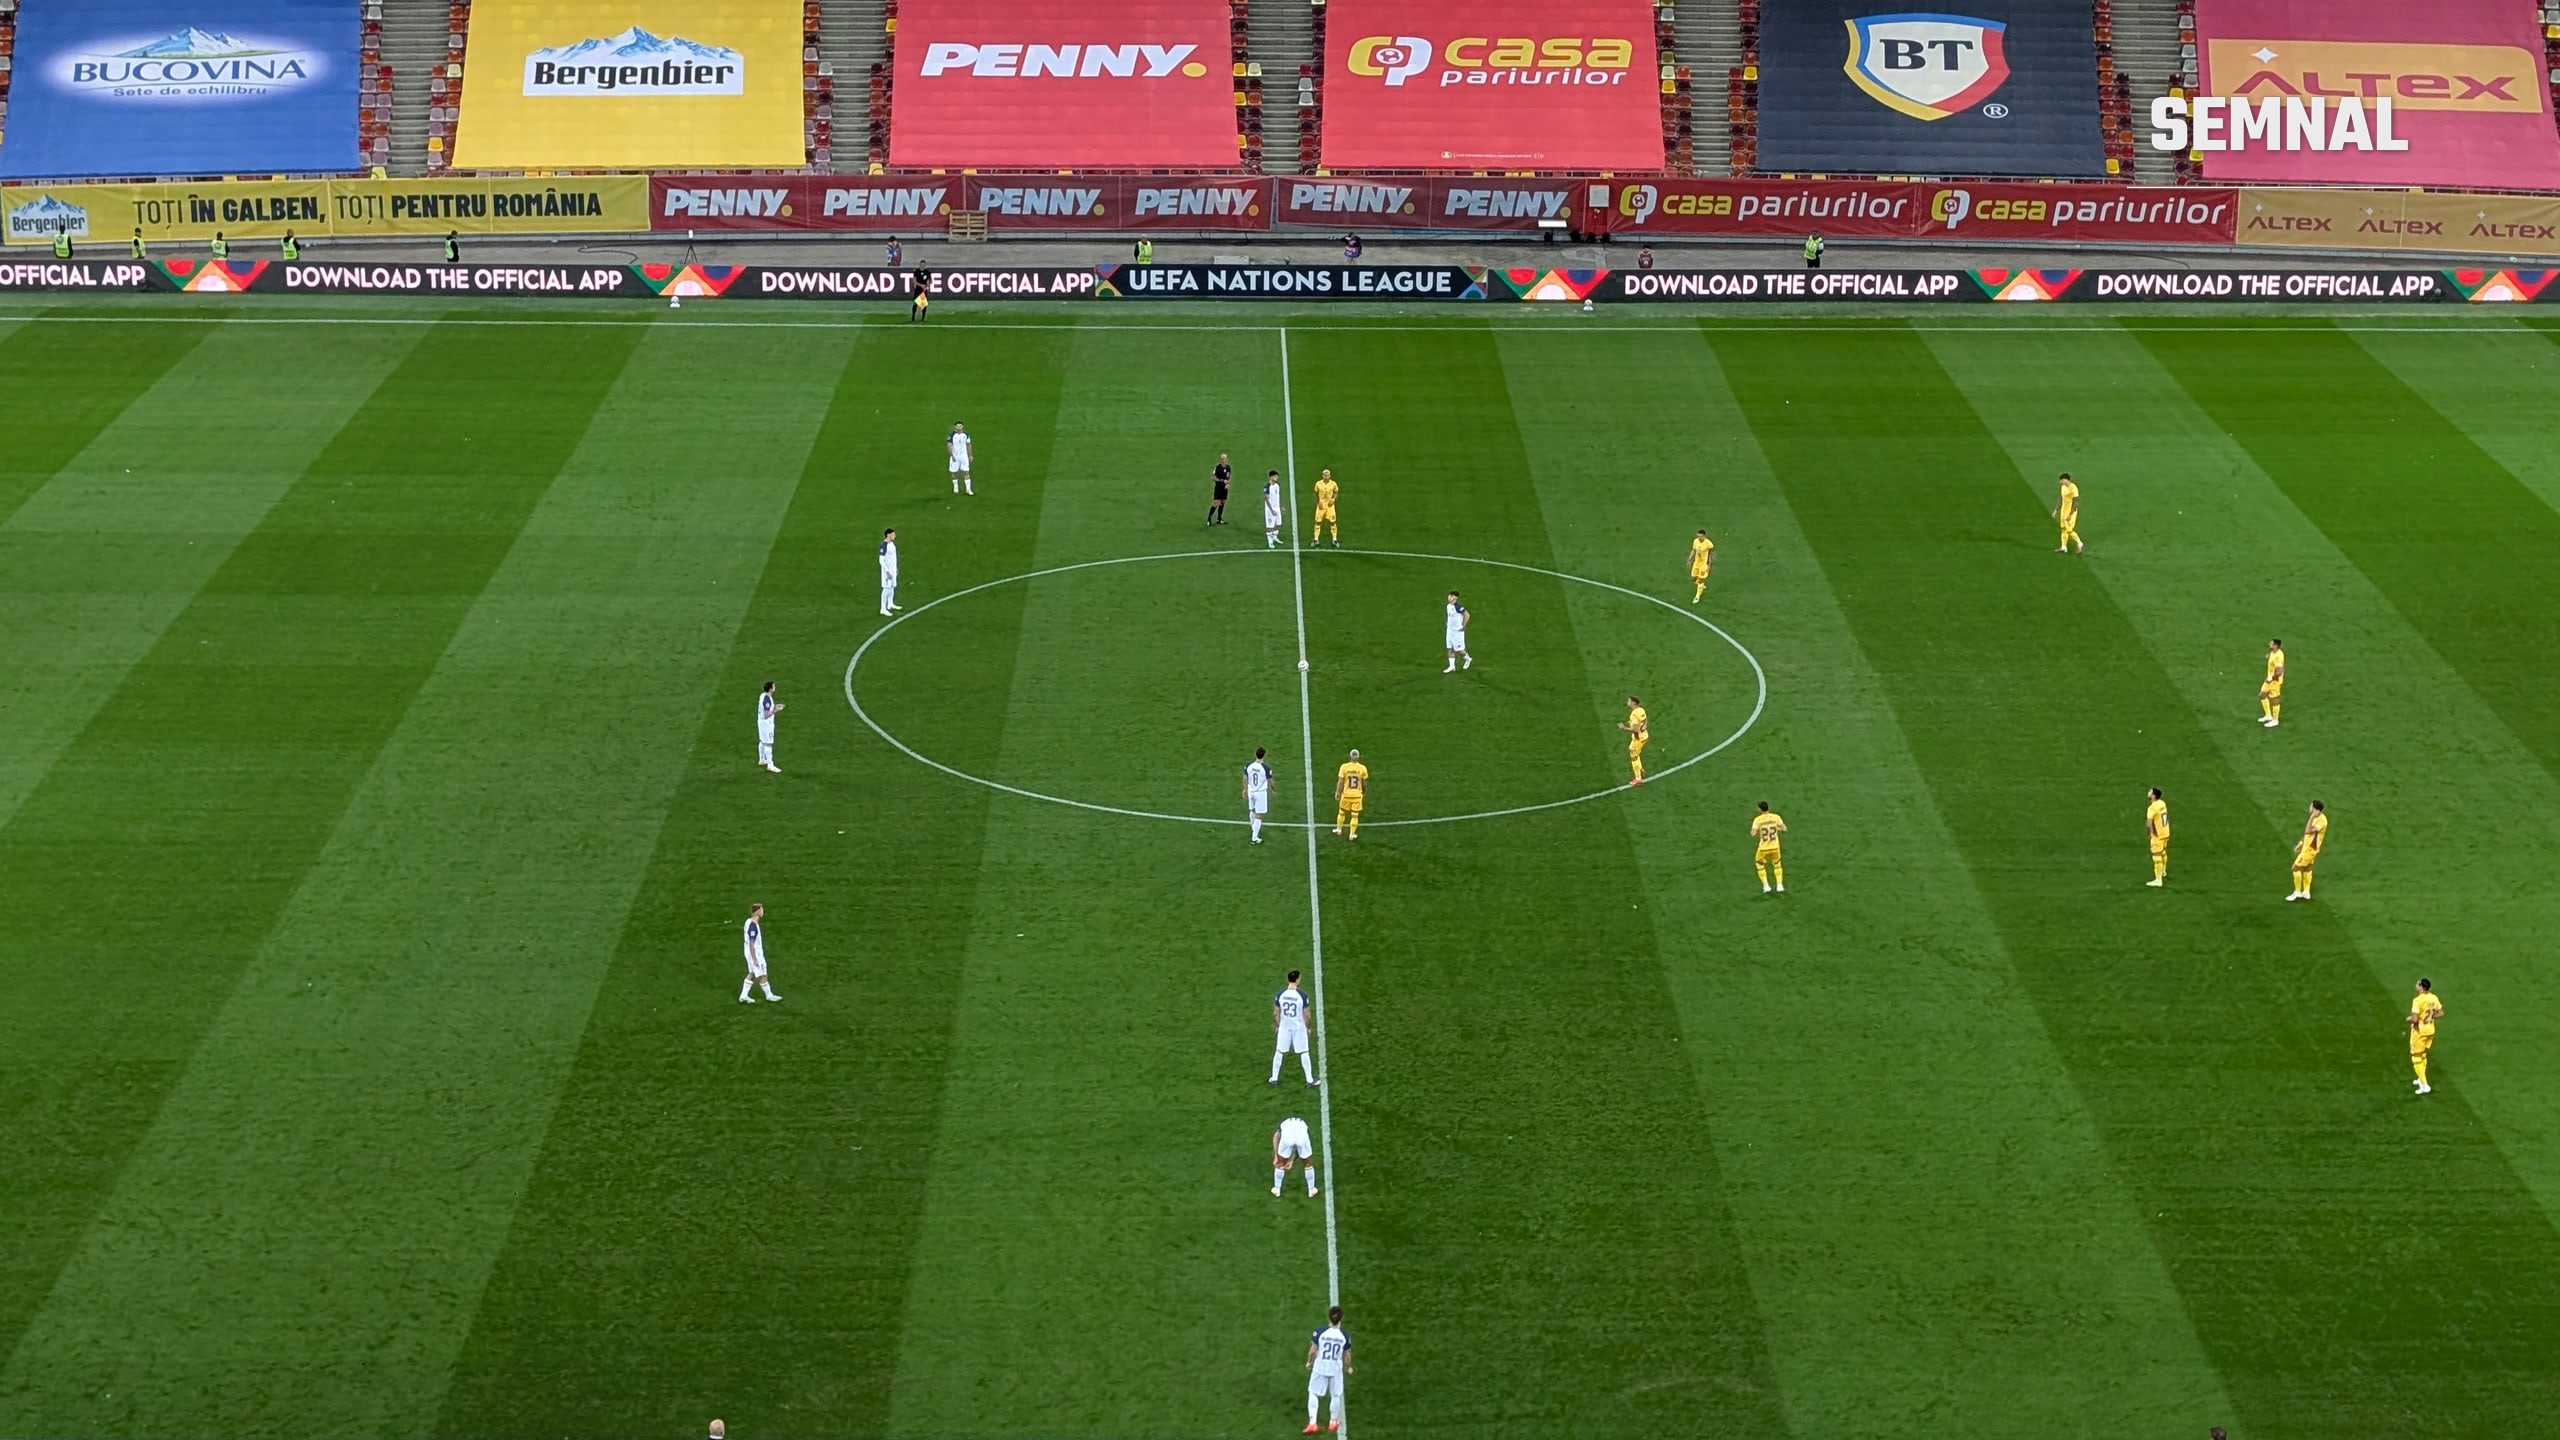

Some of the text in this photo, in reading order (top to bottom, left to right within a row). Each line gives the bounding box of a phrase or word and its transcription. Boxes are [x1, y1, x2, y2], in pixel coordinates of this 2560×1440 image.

[1444, 37, 1633, 68] casa
[1879, 38, 1974, 71] BT
[73, 59, 307, 82] BUCOVINA
[533, 59, 734, 89] Bergenbier
[1440, 67, 1627, 87] pariurilor
[113, 85, 267, 97] Sete de echilibru
[188, 194, 216, 223] ÎN
[222, 196, 326, 223] GALBEN,
[391, 193, 486, 218] PENTRU
[493, 188, 602, 217] ROMÂNIA
[1662, 194, 1732, 215] casa
[1737, 190, 1908, 221] pariurilor
[1975, 199, 2047, 221] casa
[2052, 196, 2227, 227] pariurilor
[12, 213, 85, 233] Bergenbier
[0, 264, 146, 286] OFFICIAL APP
[285, 266, 623, 291] DOWNLOAD THE OFFICIAL APP
[761, 271, 1094, 294] DOWNLOAD TE OFFICIAL APP
[1129, 269, 1451, 293] UEFA NATIONS LEAGUE
[1624, 274, 1959, 295] DOWNLOAD THE OFFICIAL APP
[2097, 274, 2434, 296] DOWNLOAD THE OFFICIAL APP
[1348, 775, 1359, 789] 13
[1761, 826, 1777, 841] 22
[1283, 1002, 1297, 1017] 23
[1322, 1342, 1341, 1360] 20
